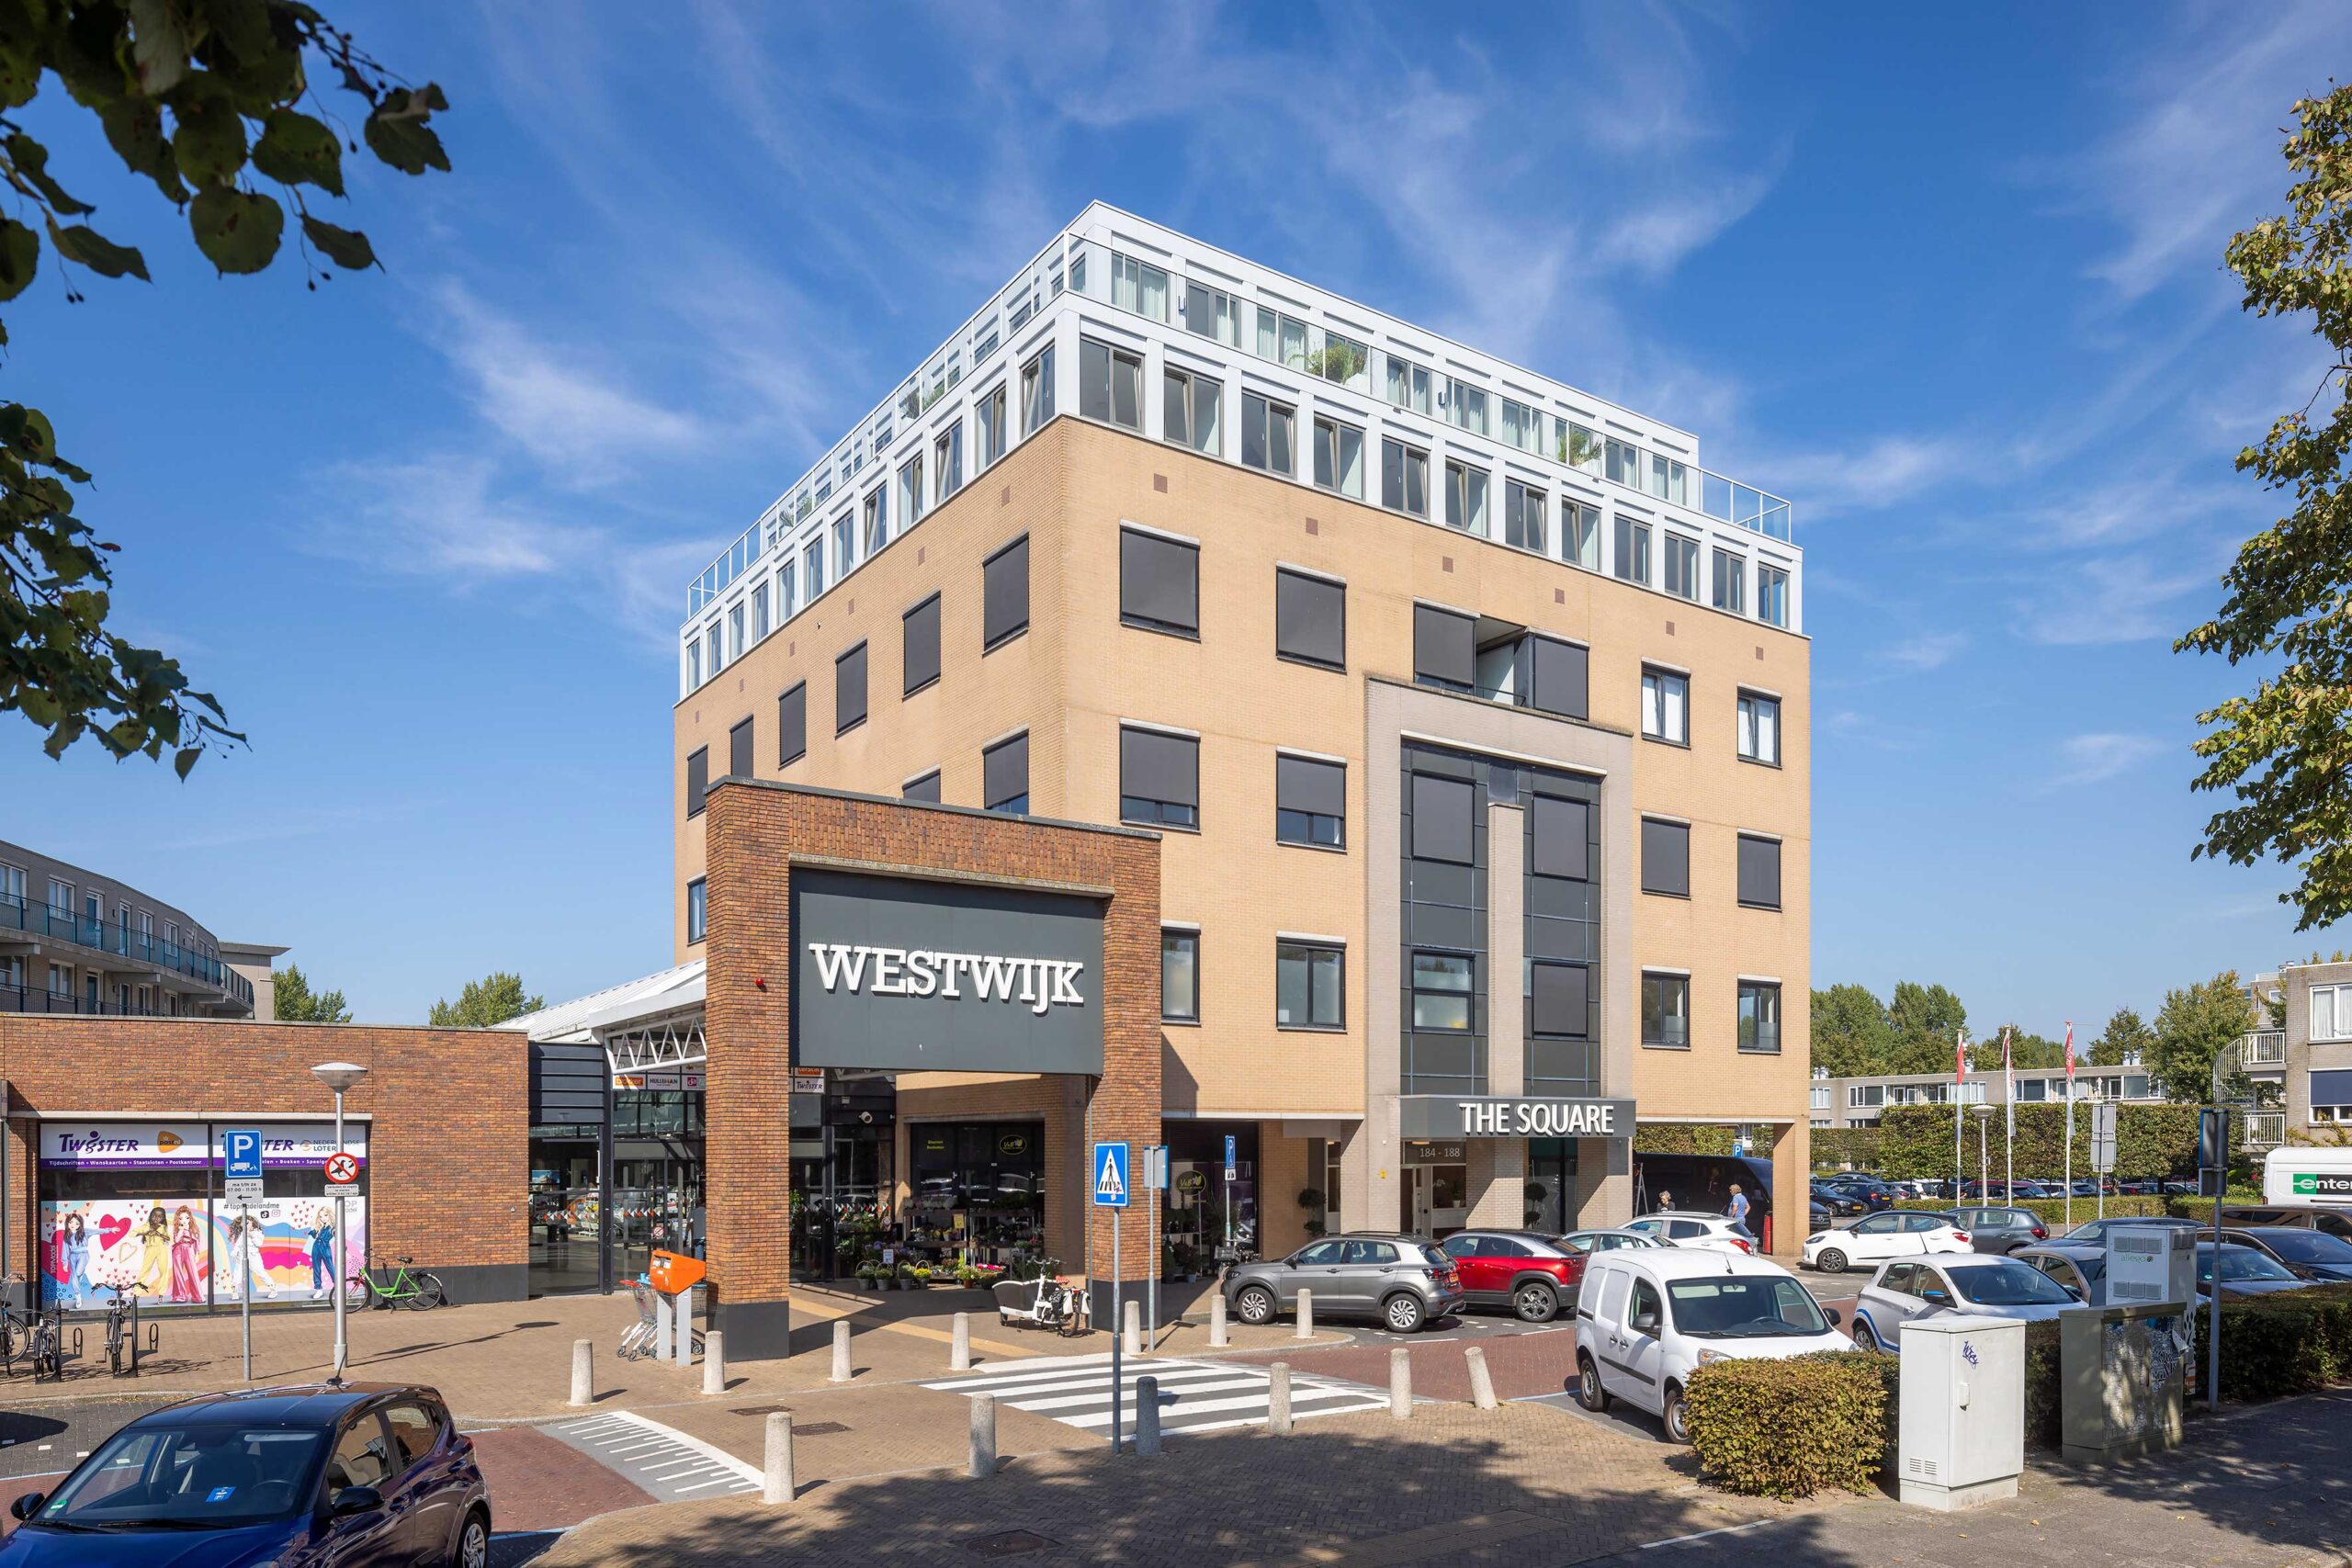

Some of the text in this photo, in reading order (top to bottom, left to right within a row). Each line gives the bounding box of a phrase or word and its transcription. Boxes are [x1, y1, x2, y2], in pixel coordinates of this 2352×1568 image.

[808, 942, 1084, 1015] WESTWIJK
[1459, 1102, 1615, 1136] THE SQUARE
[233, 1134, 254, 1159] P
[1228, 1139, 1234, 1155] P
[1419, 1148, 1436, 1157] 184
[1444, 1148, 1460, 1157] 188
[1735, 1145, 1741, 1156] P
[2297, 1179, 2352, 1190] ente
